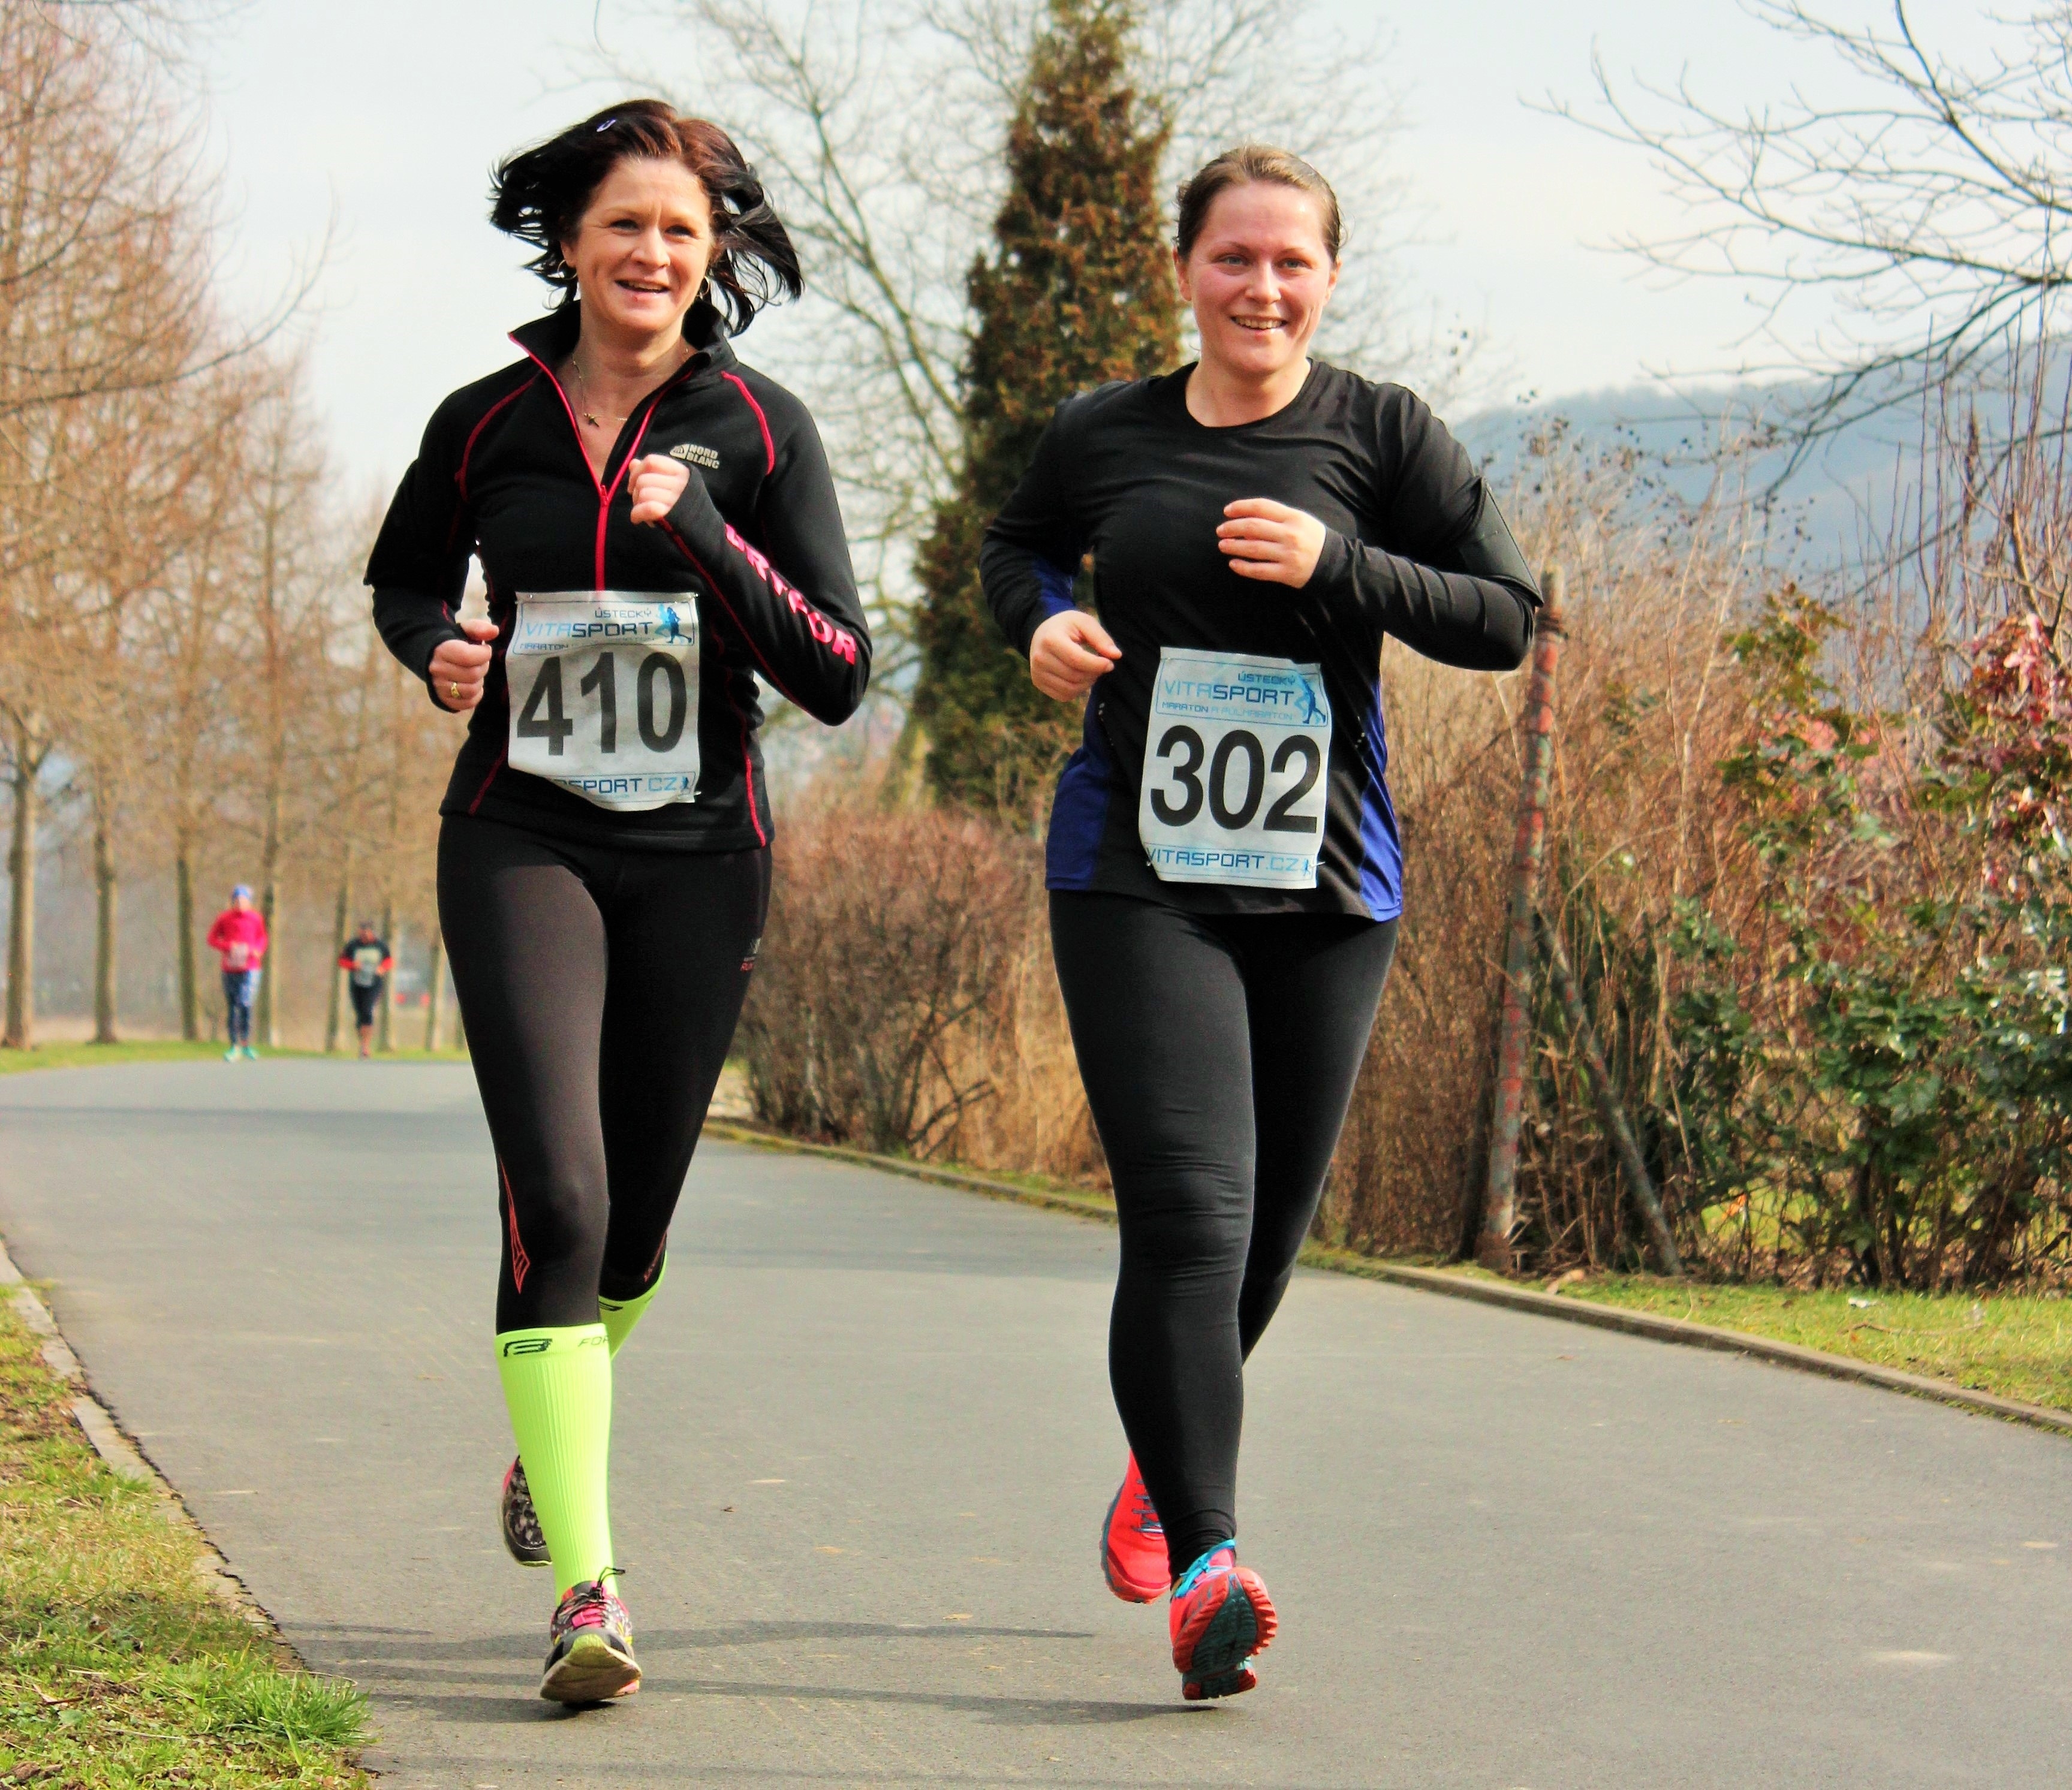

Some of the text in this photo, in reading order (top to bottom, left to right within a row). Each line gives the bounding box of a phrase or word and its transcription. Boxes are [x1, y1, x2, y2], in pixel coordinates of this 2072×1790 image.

[689, 444, 718, 459] NORD
[686, 452, 720, 469] BLANC
[526, 622, 653, 638] VITASPORT
[1164, 679, 1294, 706] VITASPORT
[517, 652, 687, 756] 410
[1162, 701, 1209, 713] MARATON
[1150, 725, 1321, 834] 302
